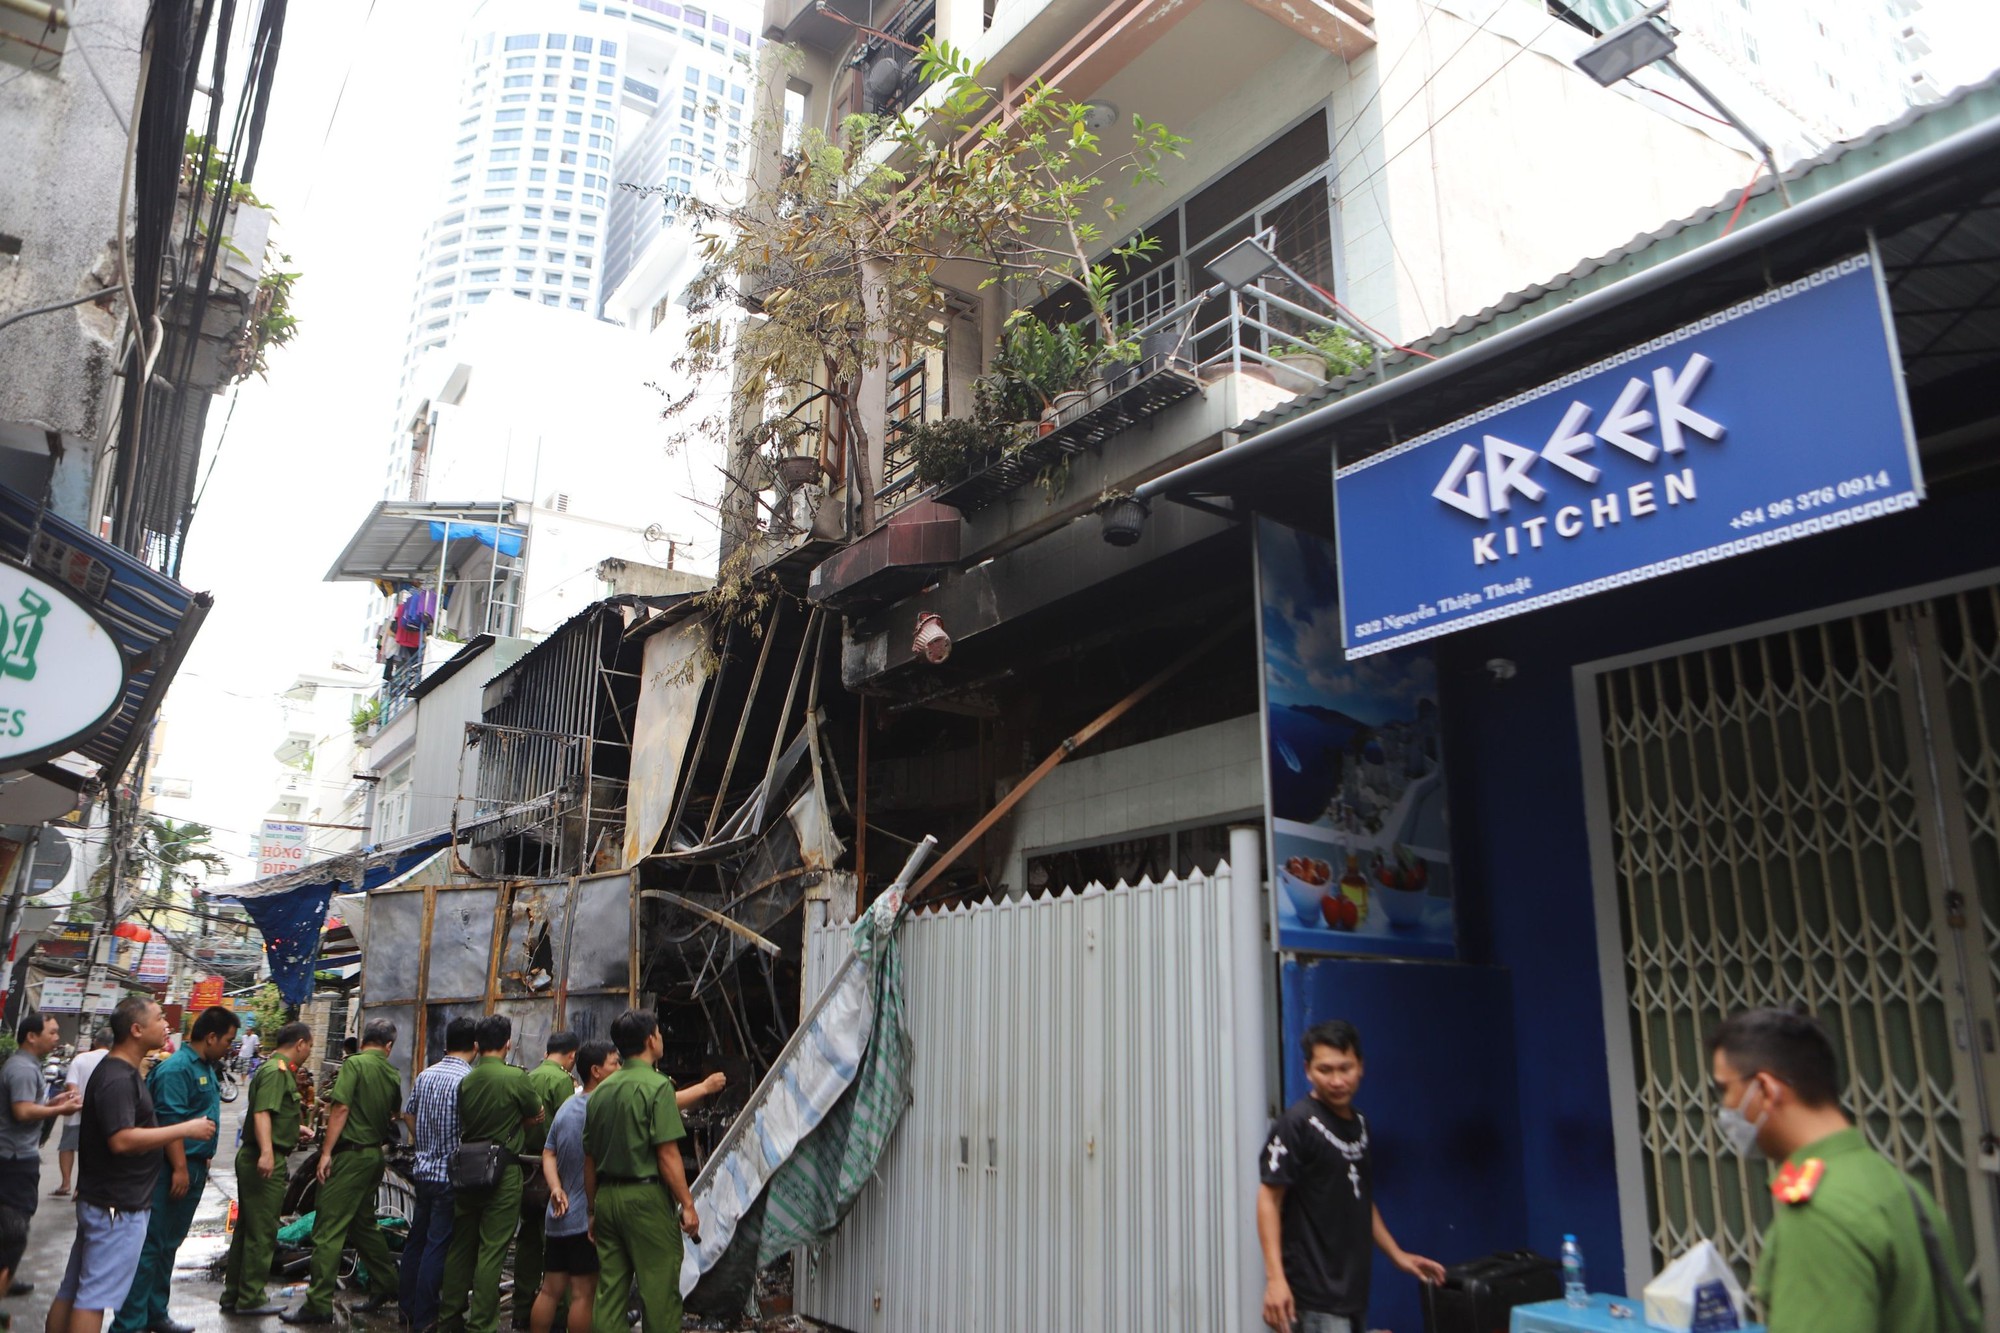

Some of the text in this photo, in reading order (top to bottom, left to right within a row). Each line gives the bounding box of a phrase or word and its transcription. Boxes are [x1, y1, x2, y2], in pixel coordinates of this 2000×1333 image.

[1432, 352, 1728, 521] GREEK
[1473, 468, 1698, 566] KITCHEN
[1729, 469, 1891, 529] +84 96 376 0914
